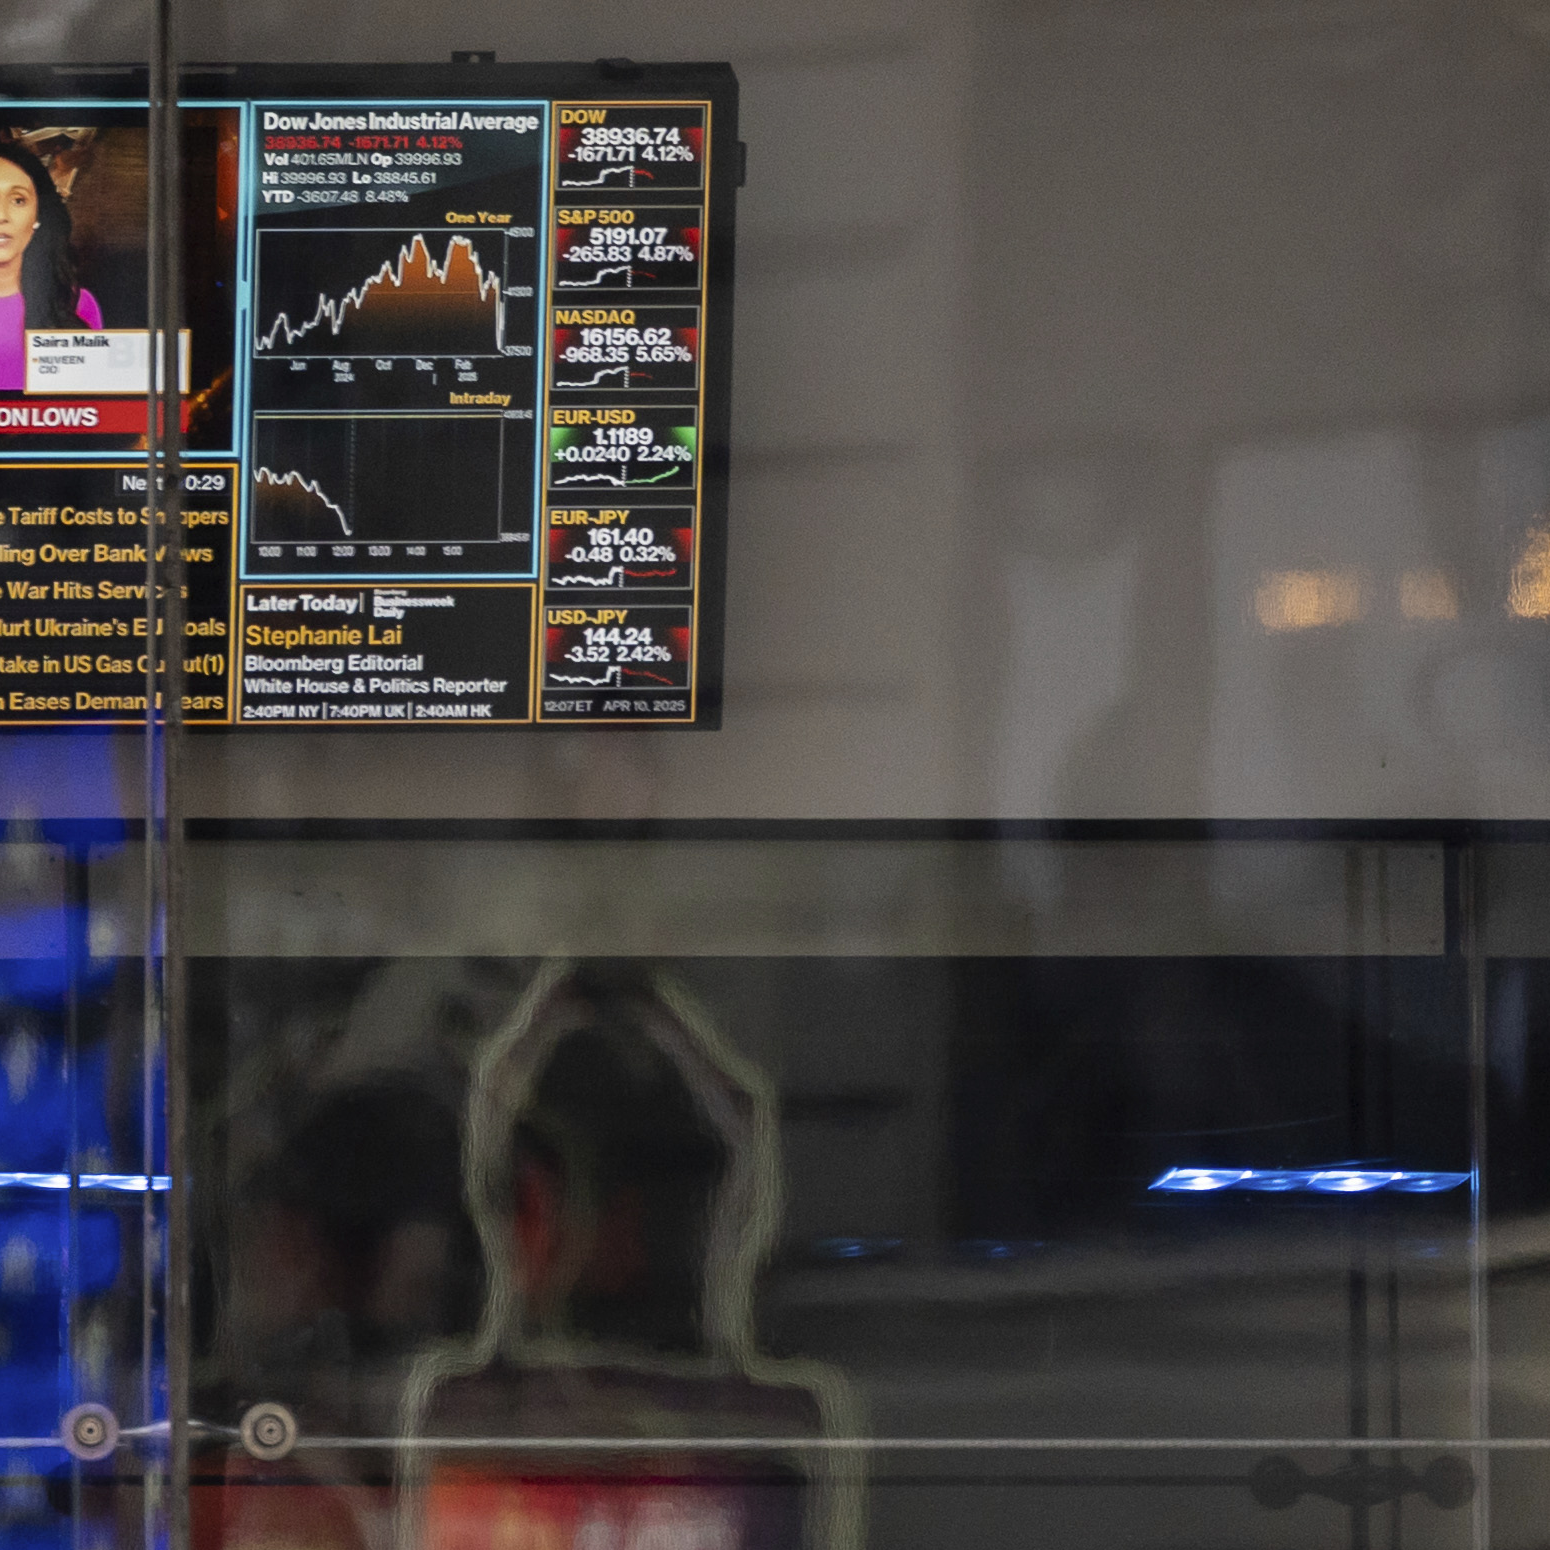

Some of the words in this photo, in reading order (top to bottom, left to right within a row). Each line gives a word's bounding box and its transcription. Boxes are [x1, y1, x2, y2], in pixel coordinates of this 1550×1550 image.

[263, 112, 308, 131] Dow
[309, 112, 367, 131] Jones
[369, 112, 456, 131] Industrial
[459, 112, 539, 134] Average
[561, 109, 606, 124] DOW
[581, 128, 680, 145] 38936.74
[568, 147, 635, 162] -1671.71
[642, 147, 693, 162] 4.12%
[559, 210, 595, 224] S&P
[597, 210, 634, 224] 500
[589, 228, 667, 245] 5191.07
[562, 247, 632, 262] -265.83
[637, 247, 694, 262] 4.87%
[555, 310, 635, 325] NASDAQ
[32, 335, 68, 348] Saira
[71, 335, 110, 348] Malik
[580, 329, 671, 345] 16156.62
[559, 347, 630, 362] -968.35
[636, 347, 692, 362] 5.65%
[31, 406, 98, 426] LOWS
[553, 410, 636, 424] EUR-USD
[593, 428, 653, 445] 1.1189
[554, 446, 630, 461] +0.0240
[637, 446, 692, 461] 2.24%
[8, 507, 56, 525] Tariff
[60, 507, 113, 525] Costs
[117, 508, 137, 525] to
[551, 510, 629, 524] EUR-JPY
[588, 528, 654, 545] 161.40
[39, 545, 91, 562] Over
[94, 544, 147, 562] Bank
[7, 582, 48, 599] War
[53, 582, 93, 599] Hits
[548, 610, 628, 624] USD-JPY
[35, 618, 128, 636] Ukraine's
[246, 625, 363, 649] Stephanie
[368, 625, 402, 645] Lai
[583, 628, 653, 645] 144.24
[42, 655, 60, 673] in
[63, 655, 93, 673] US
[96, 655, 133, 673] Gas
[244, 654, 344, 674] Bloomberg
[347, 654, 424, 671] Editorial
[9, 692, 70, 710] Eases
